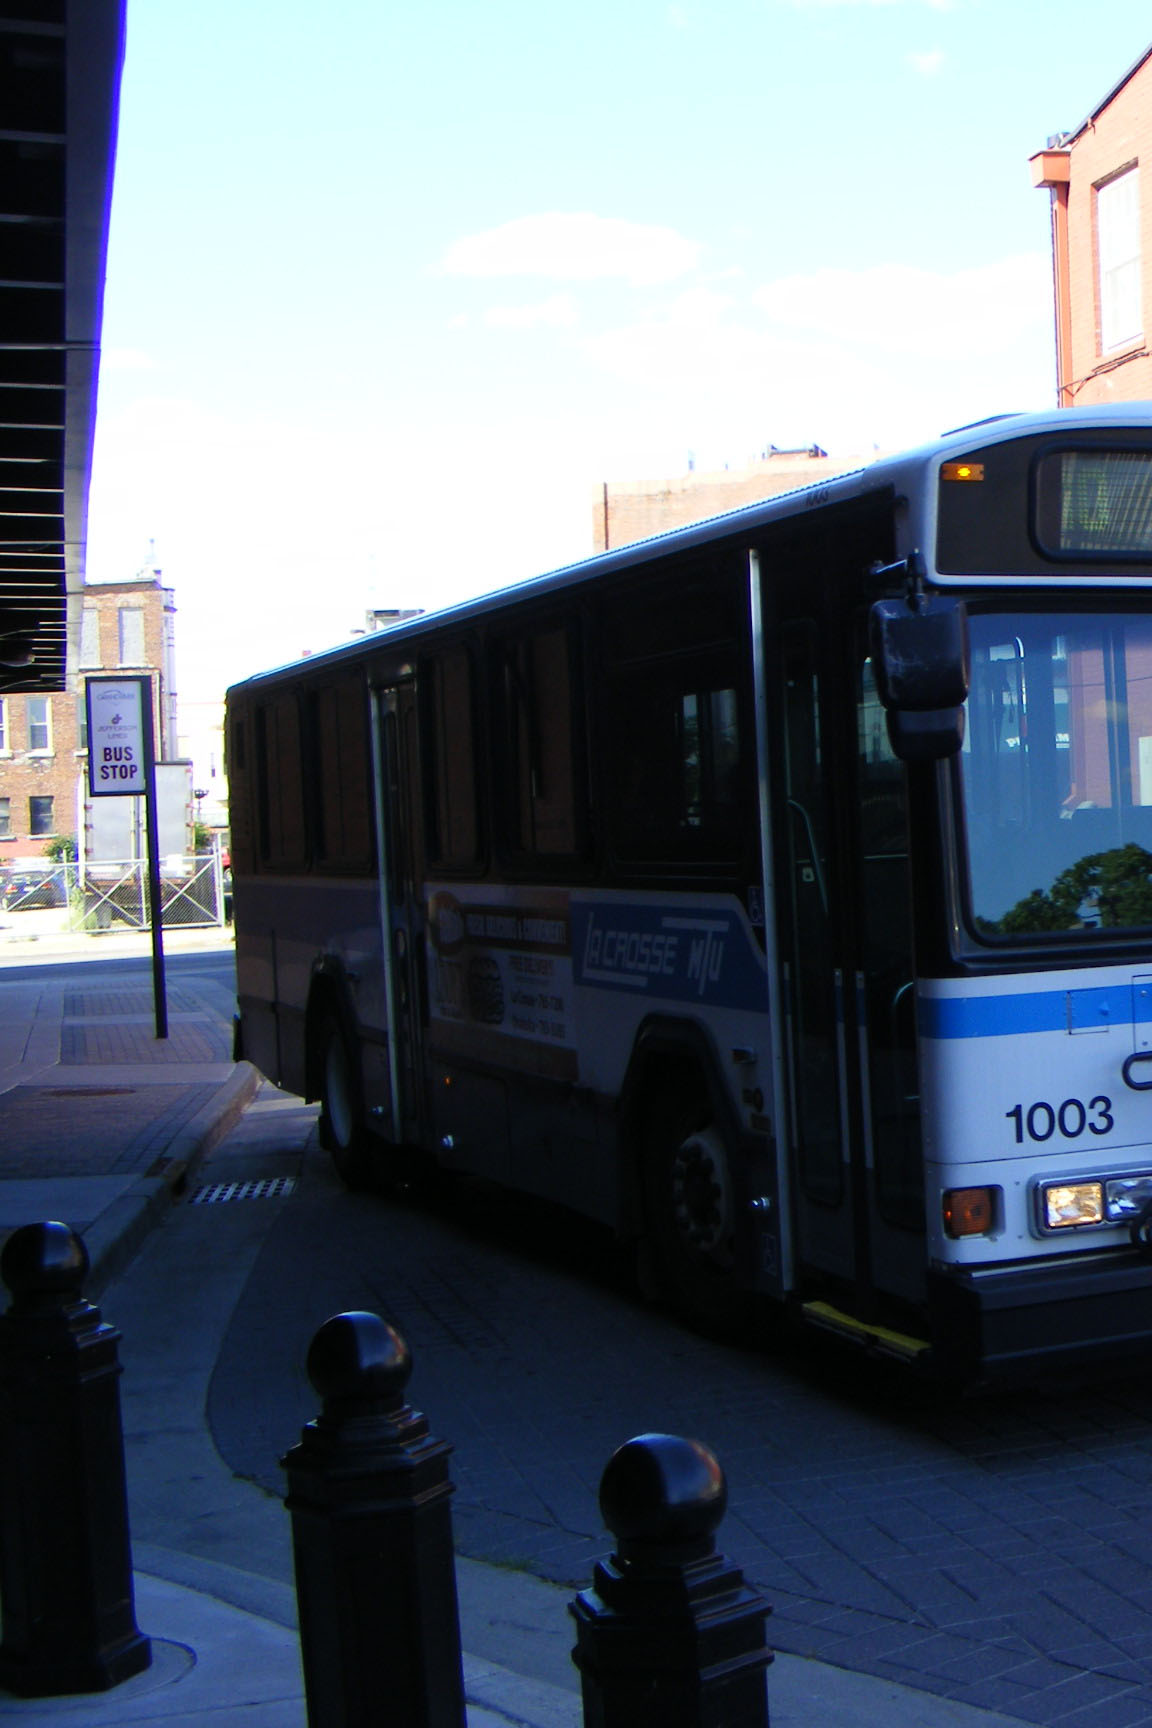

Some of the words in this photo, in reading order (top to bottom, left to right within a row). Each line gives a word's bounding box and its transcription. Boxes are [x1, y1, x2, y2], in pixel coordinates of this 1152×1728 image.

[103, 747, 133, 761] BUS
[100, 764, 137, 779] STOP
[661, 916, 730, 995] MTU
[1005, 1095, 1114, 1144] 1003
